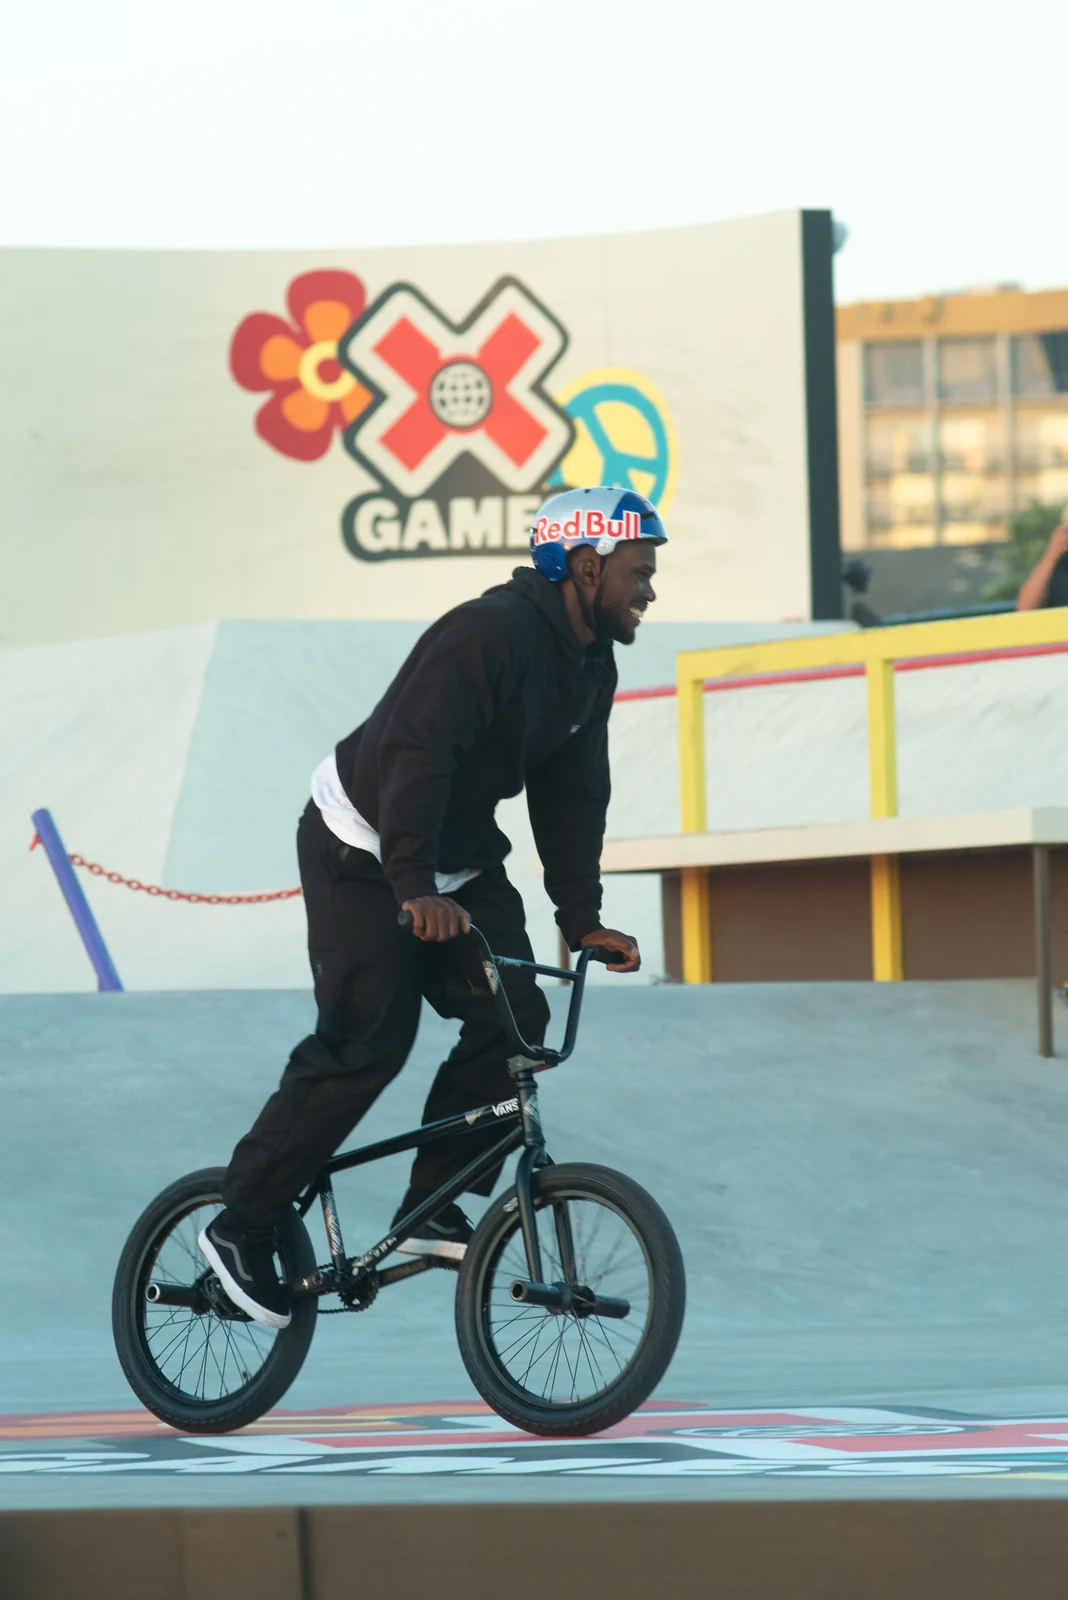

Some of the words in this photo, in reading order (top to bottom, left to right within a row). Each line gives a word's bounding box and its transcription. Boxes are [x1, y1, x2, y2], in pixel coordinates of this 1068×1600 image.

[353, 497, 540, 554] GAME
[535, 511, 581, 544] Red
[585, 511, 640, 539] Bull
[492, 1098, 519, 1117] VANS
[0, 1452, 1068, 1476] GAMES
